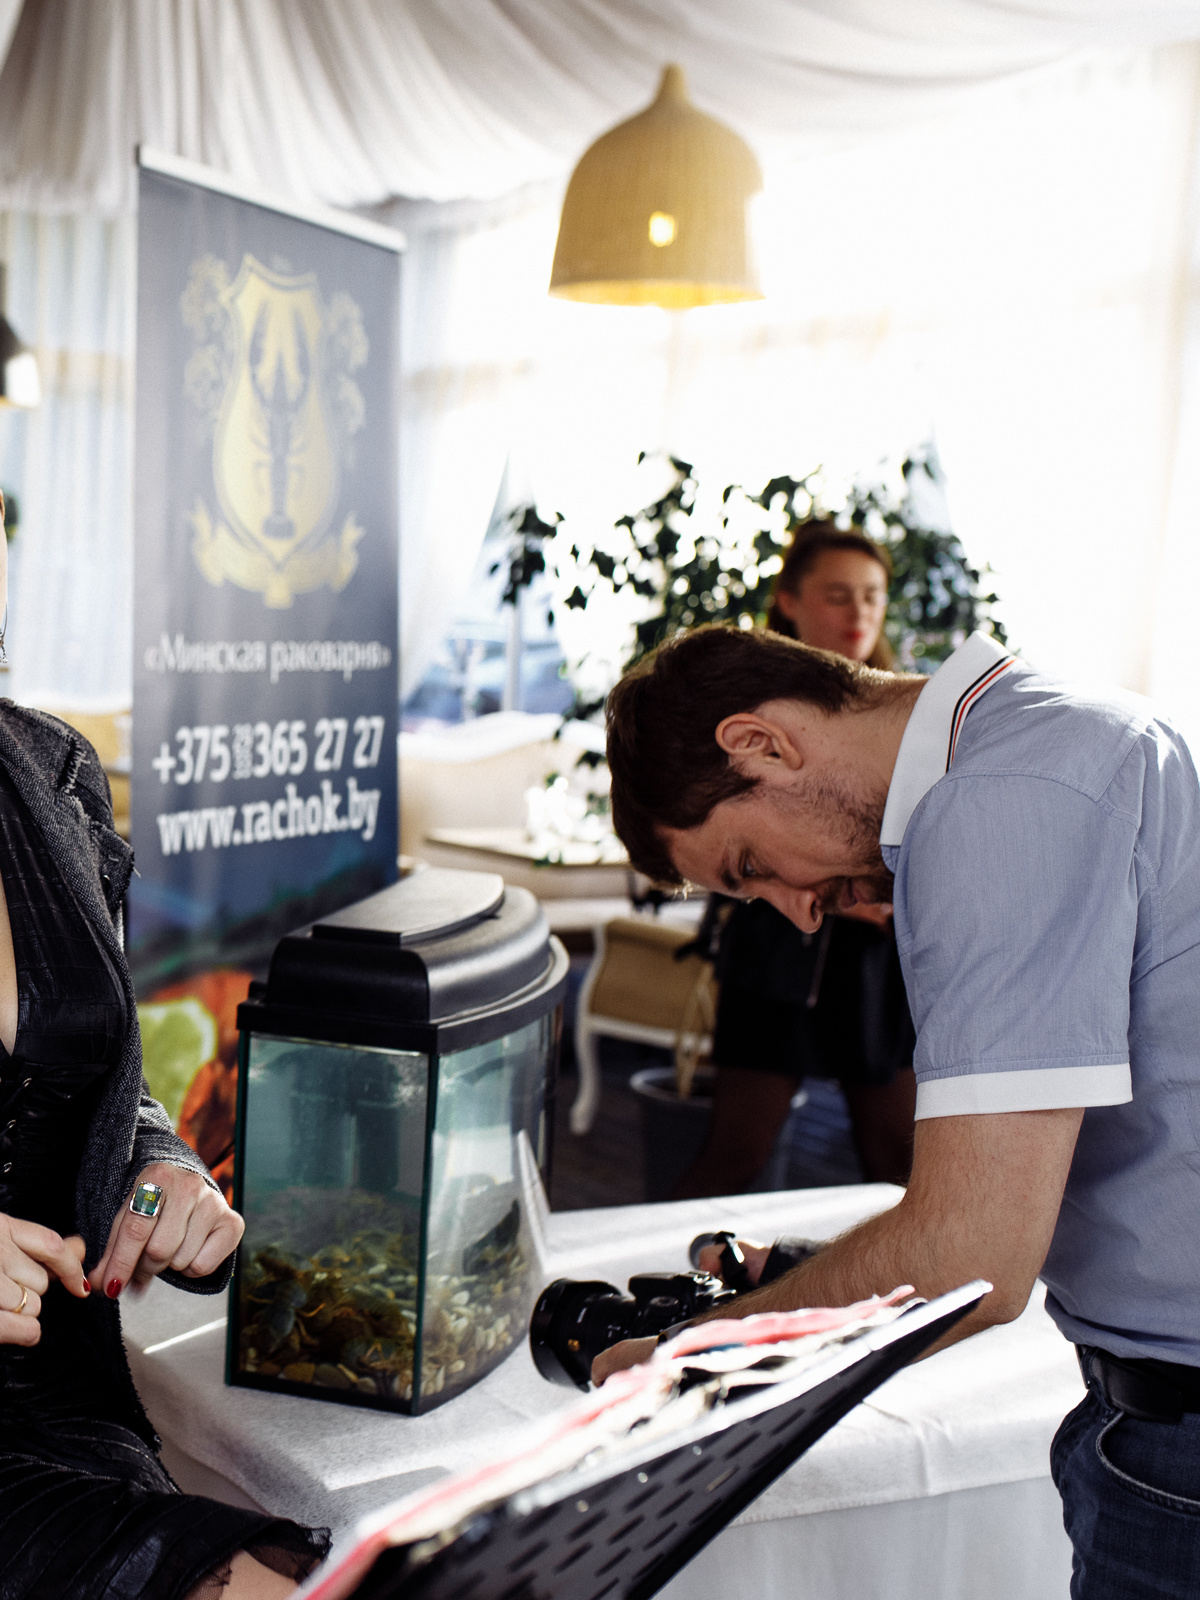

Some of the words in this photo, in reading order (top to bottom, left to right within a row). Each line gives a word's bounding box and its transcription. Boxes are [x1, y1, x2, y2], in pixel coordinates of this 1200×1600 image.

[153, 725, 231, 783] +375
[254, 720, 308, 776] 365
[314, 718, 347, 771] 27
[354, 716, 384, 768] 27
[157, 778, 380, 855] www.rachok.by
